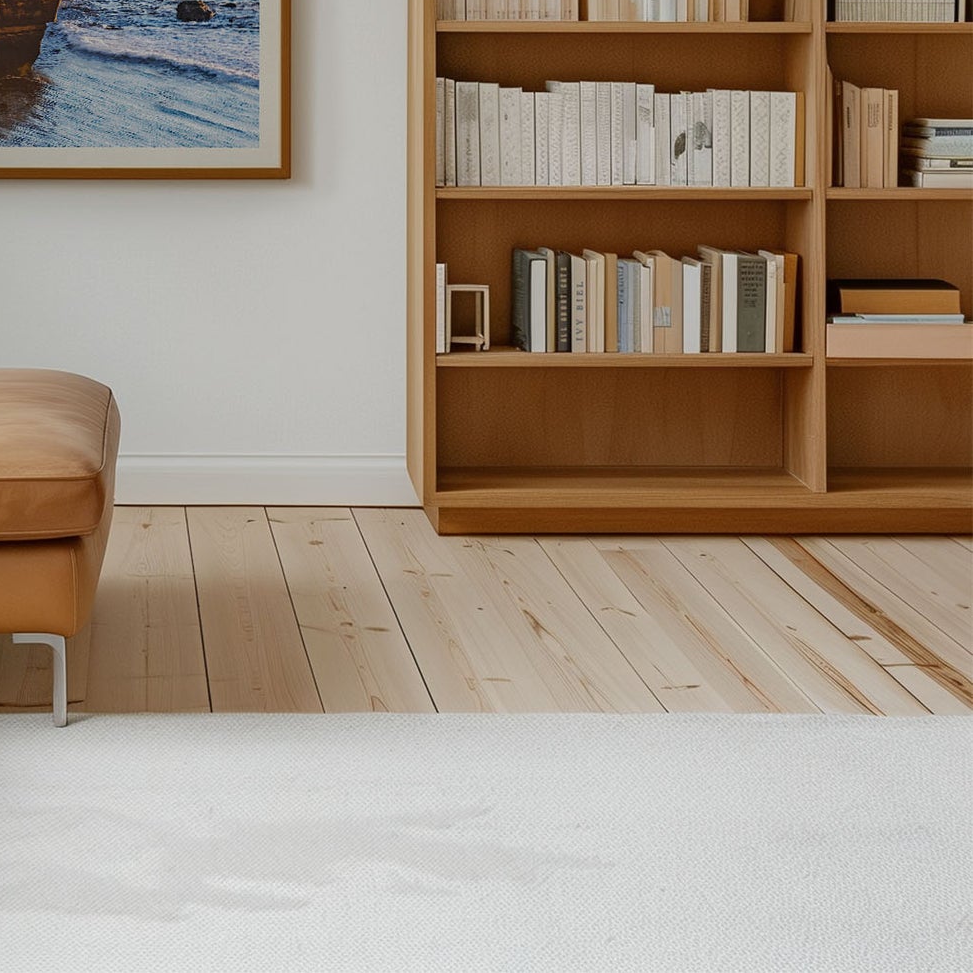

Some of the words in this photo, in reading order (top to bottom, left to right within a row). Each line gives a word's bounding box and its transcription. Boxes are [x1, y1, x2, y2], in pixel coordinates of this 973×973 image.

[575, 281, 584, 311] BIEL
[560, 327, 568, 343] ALL
[575, 319, 584, 342] IVY
